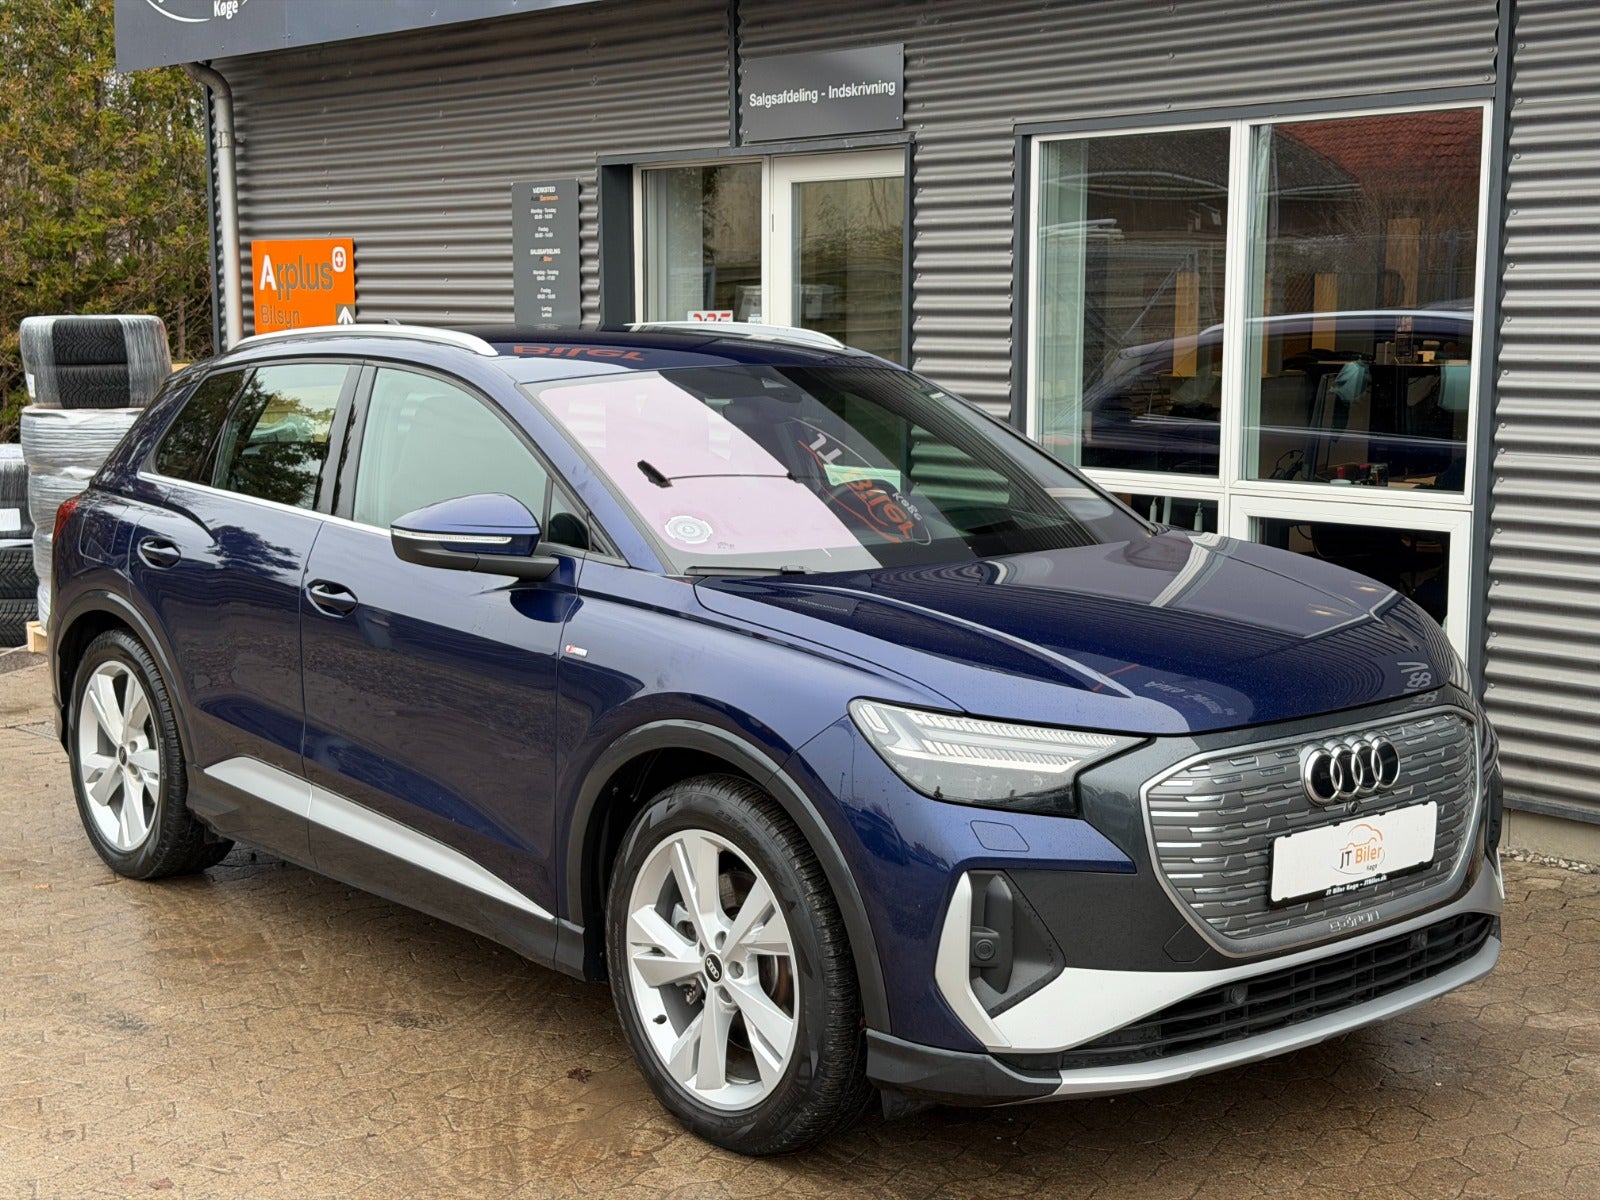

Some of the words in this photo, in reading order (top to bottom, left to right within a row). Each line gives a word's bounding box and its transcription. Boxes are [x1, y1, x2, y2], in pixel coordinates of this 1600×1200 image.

[213, 0, 239, 20] Køge
[749, 87, 818, 109] Salgsafdeling
[828, 79, 896, 99] Indskrivning
[261, 304, 300, 329] Bilsyn
[1339, 850, 1352, 870] JT
[1355, 845, 1382, 864] Biler
